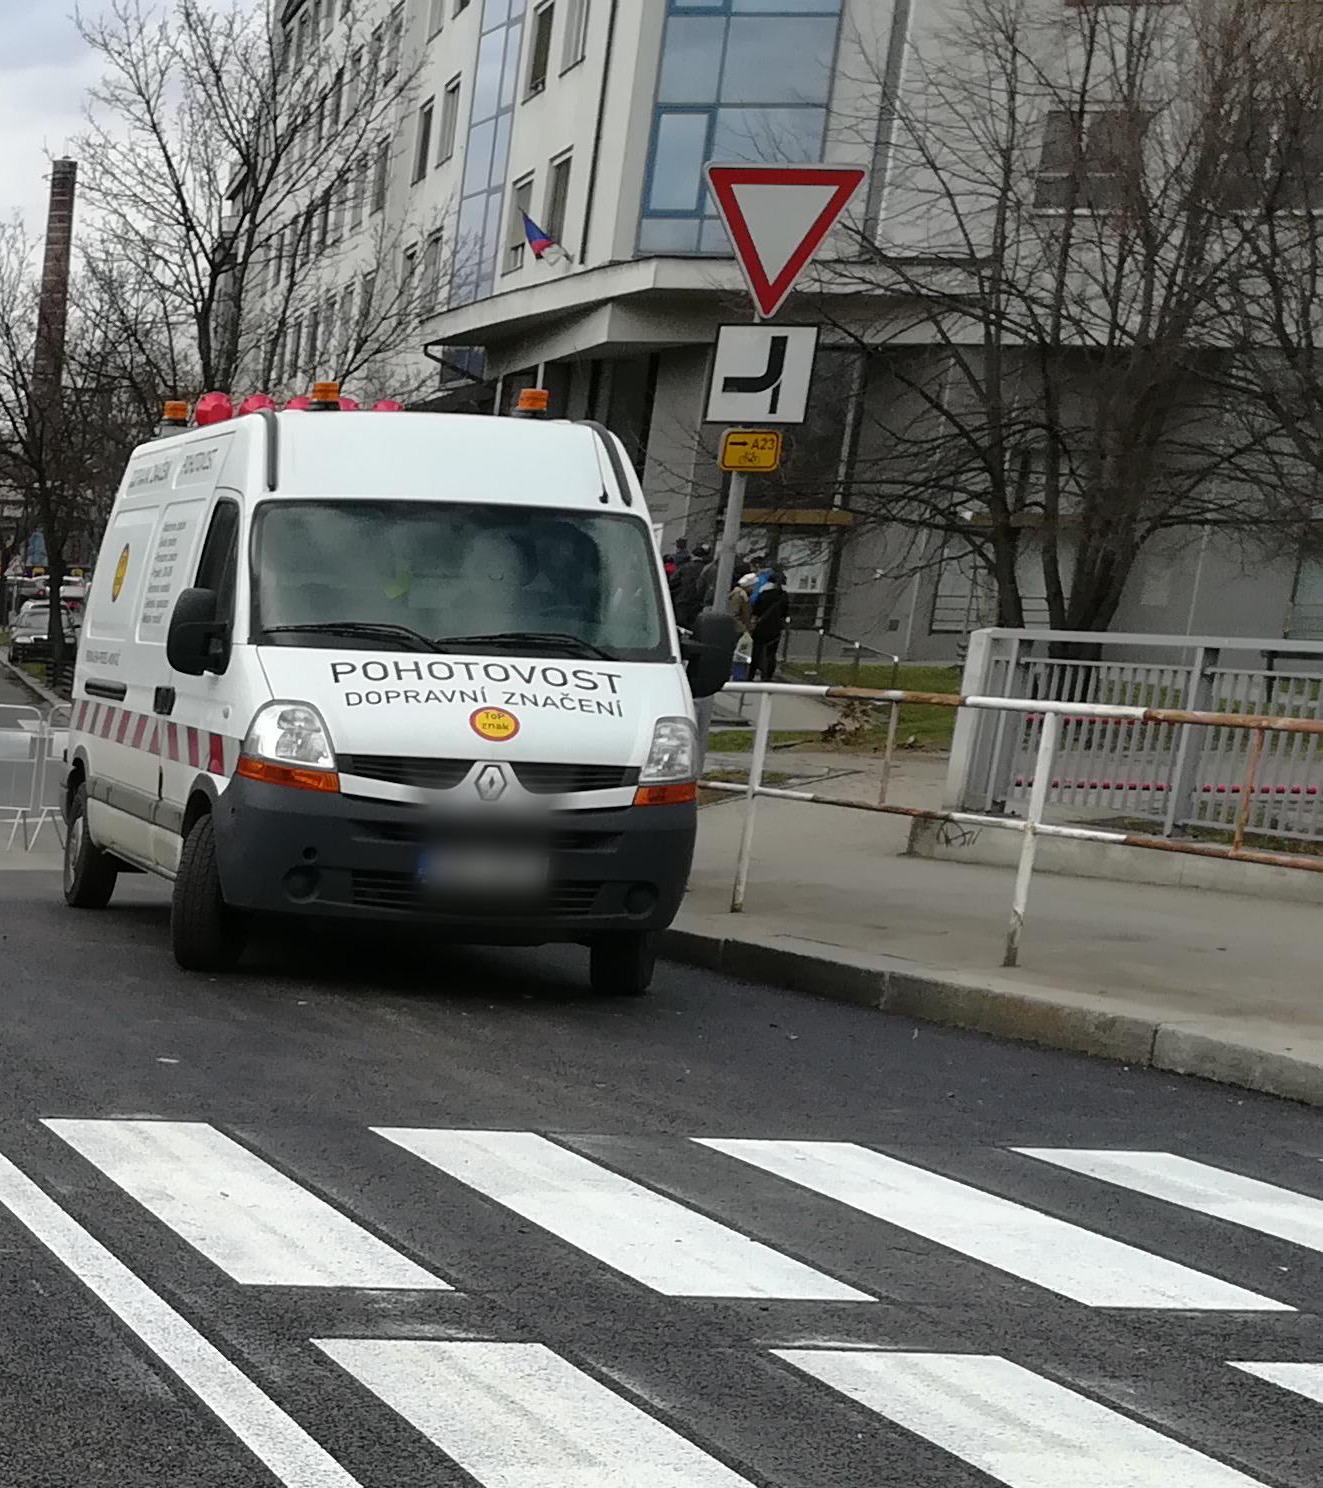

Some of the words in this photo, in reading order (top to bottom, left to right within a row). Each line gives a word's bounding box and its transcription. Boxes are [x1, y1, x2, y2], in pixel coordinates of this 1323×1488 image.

[750, 438, 775, 450] A23
[331, 661, 622, 694] POHOTOVOST
[345, 687, 487, 706] DOPRAVNÍ
[502, 691, 623, 717] ZNAČENÍ
